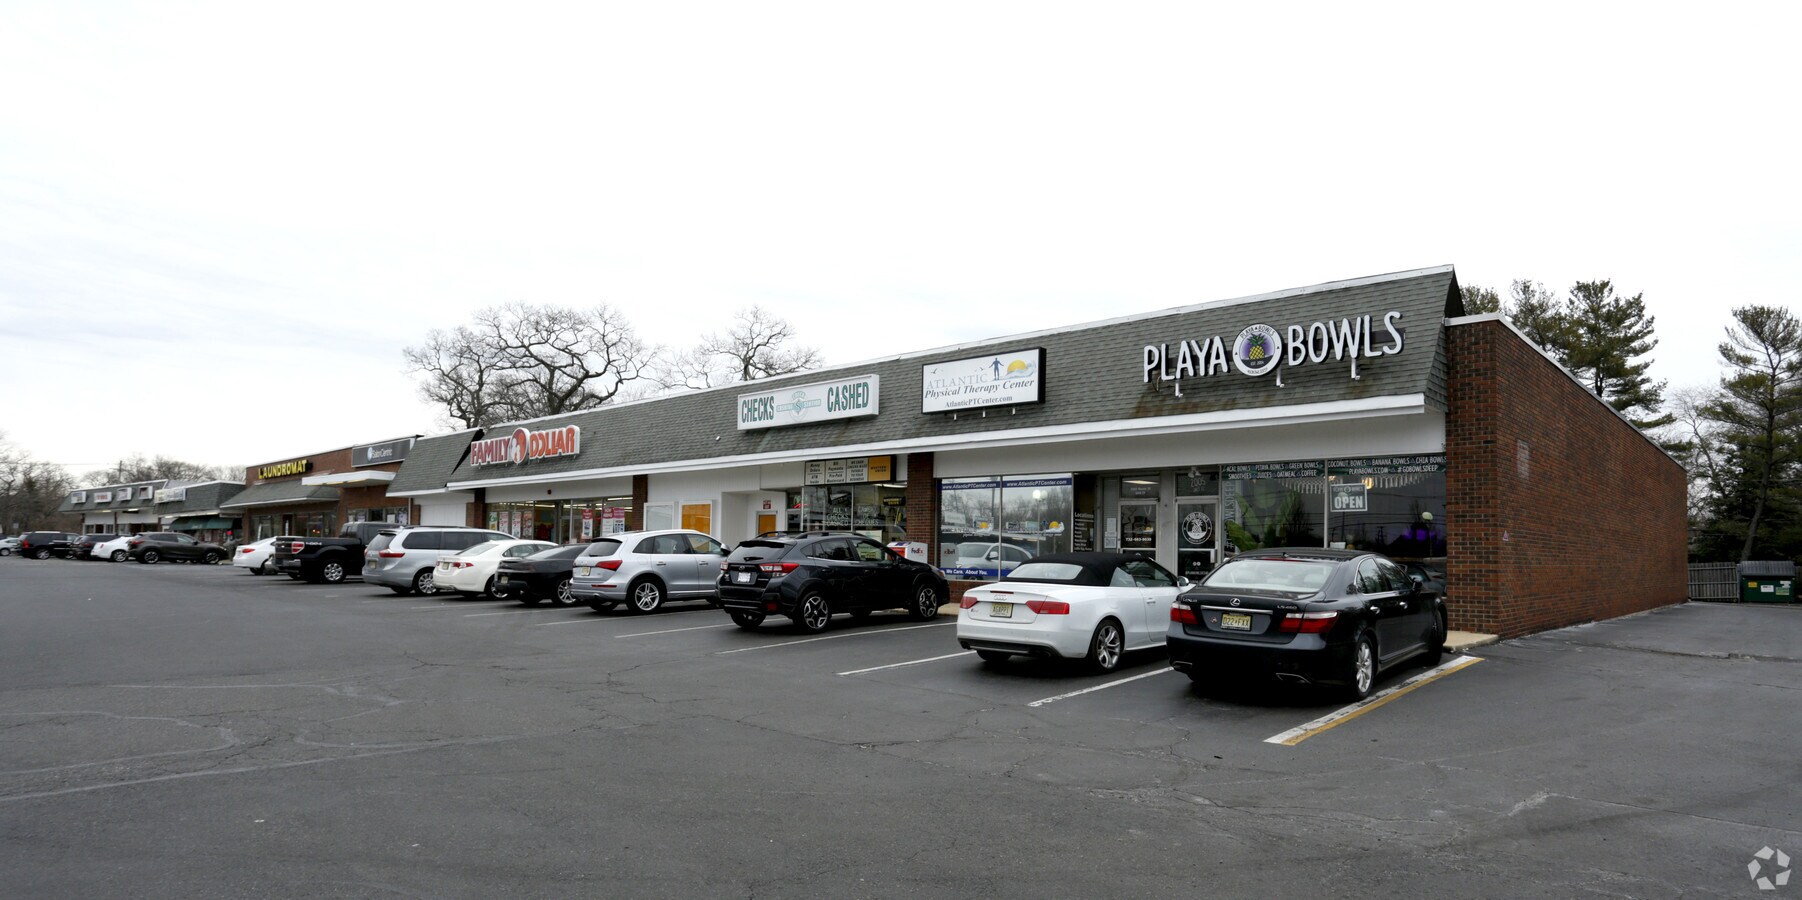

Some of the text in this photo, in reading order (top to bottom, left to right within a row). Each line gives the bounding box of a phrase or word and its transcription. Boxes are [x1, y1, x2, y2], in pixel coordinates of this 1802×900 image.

[1240, 326, 1275, 340] PLAYA BOWLS
[1144, 311, 1402, 382] PLAYA BOWLS
[924, 379, 1034, 400] Physical Therapy Center
[926, 374, 988, 389] ATLANTIC
[742, 382, 869, 423] CHECKS CASHED
[945, 395, 1012, 408] AtlanticPTCenter.com
[472, 427, 576, 464] FAMILY DOLLAR
[258, 460, 308, 479] LAUNDROMAT
[1398, 465, 1438, 473] #GOBOWLSDEEP
[1334, 496, 1363, 509] OPEN
